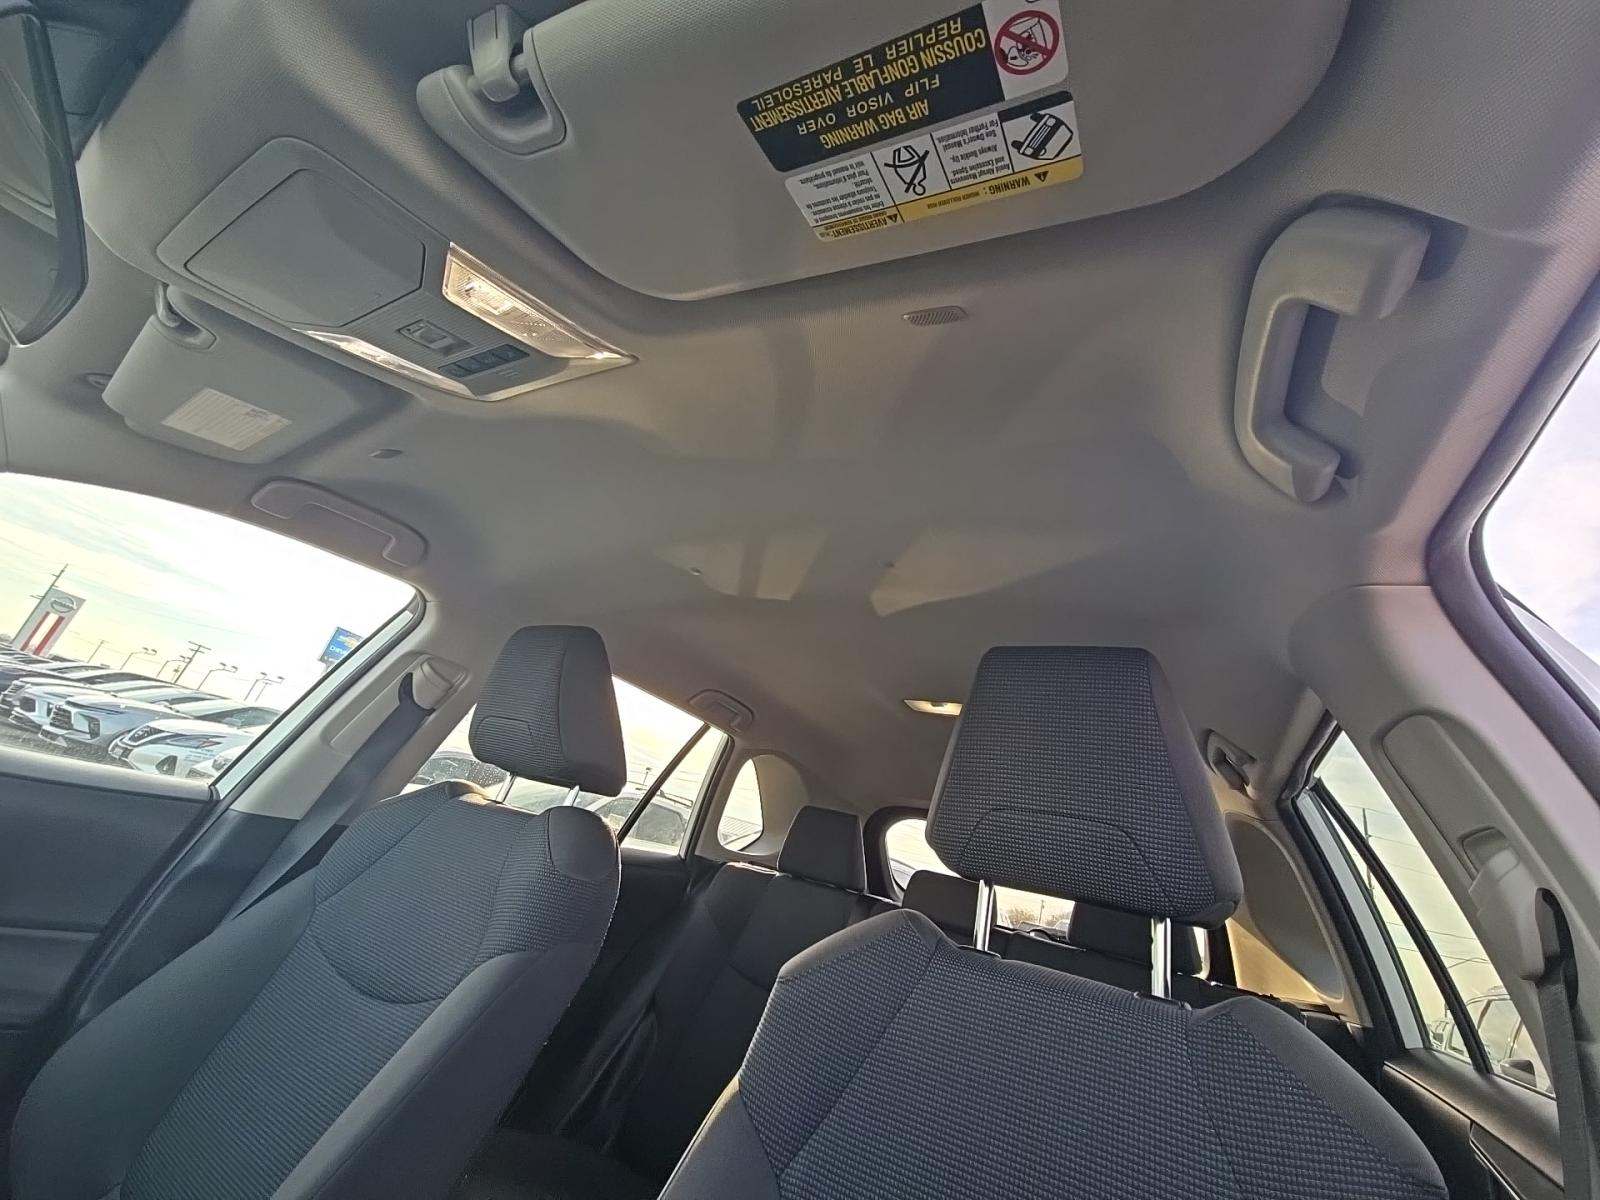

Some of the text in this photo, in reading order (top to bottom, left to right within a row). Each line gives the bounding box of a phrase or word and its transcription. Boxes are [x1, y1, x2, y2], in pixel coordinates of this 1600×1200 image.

[750, 16, 963, 112] REPLIER LE PARESOLEIL
[747, 26, 987, 132] COUSSIN GONFLABLE AVERTISSEMENT
[795, 72, 941, 135] FLIP VISOR OVER
[818, 98, 931, 149] AIR BAG WARNING
[968, 122, 988, 135] Further
[988, 119, 998, 128] For
[985, 129, 996, 139] See
[942, 140, 962, 152] Manual
[977, 142, 998, 156] Always
[959, 150, 978, 161] Buckle
